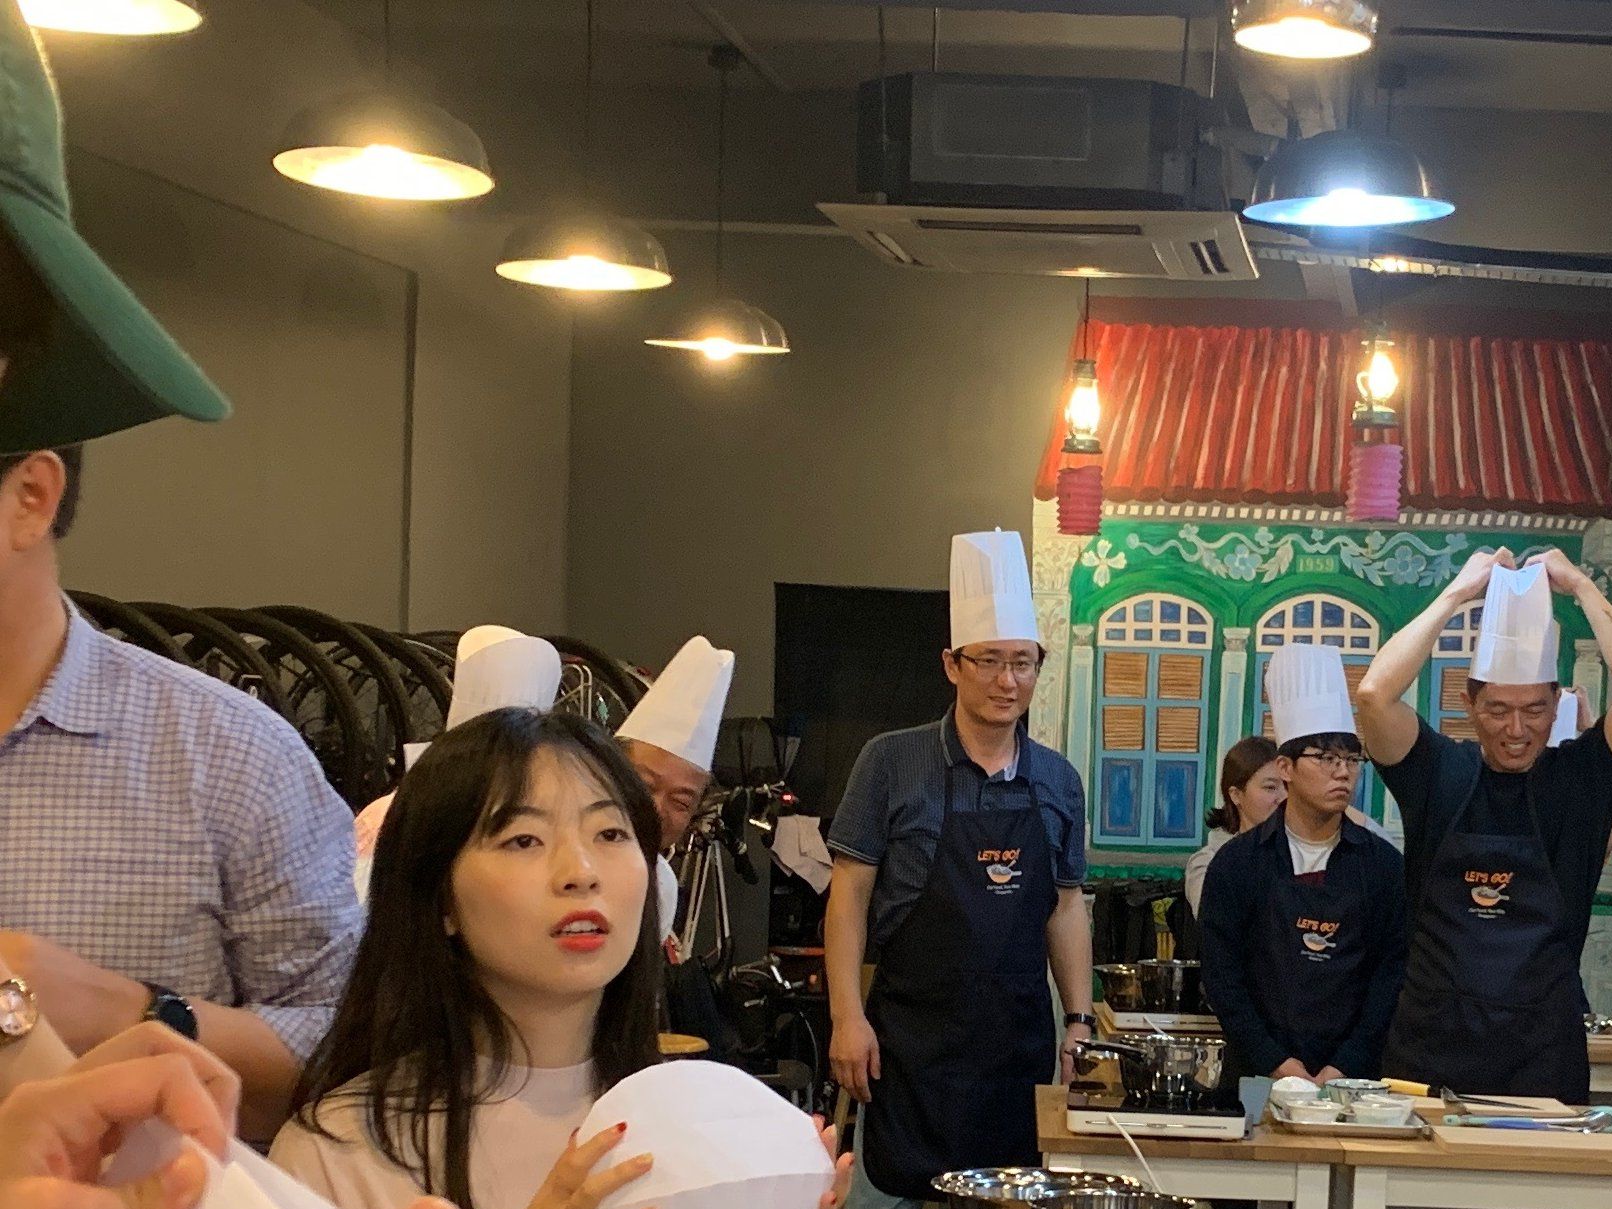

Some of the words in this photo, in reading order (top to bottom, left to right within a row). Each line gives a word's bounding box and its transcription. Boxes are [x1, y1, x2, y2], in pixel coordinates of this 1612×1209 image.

[1299, 557, 1334, 572] 1959
[1002, 848, 1021, 861] GO!
[1465, 870, 1488, 883] LET'S
[1490, 872, 1513, 884] GO!
[1320, 922, 1340, 932] GO!
